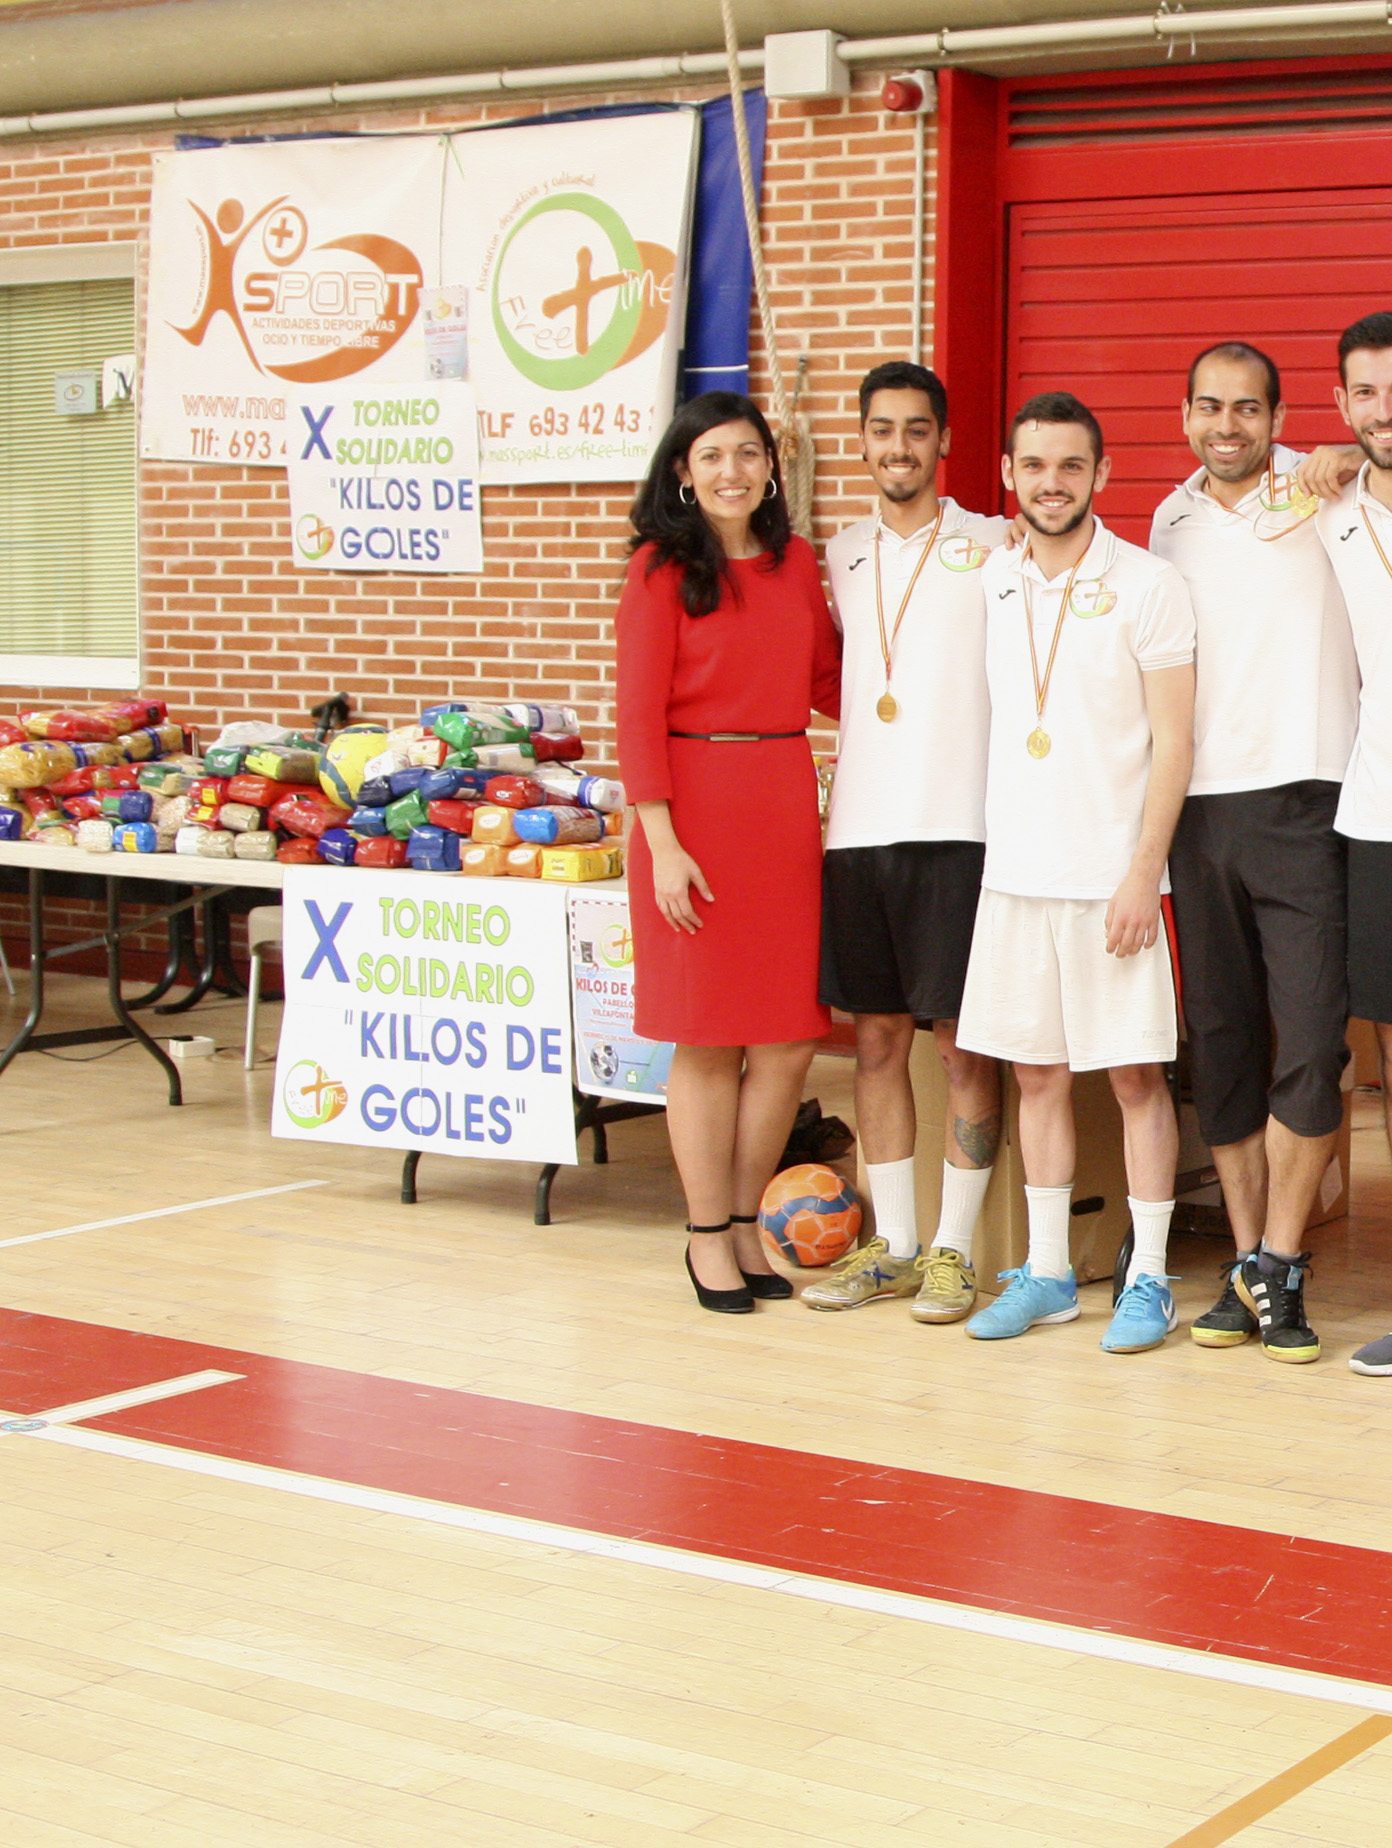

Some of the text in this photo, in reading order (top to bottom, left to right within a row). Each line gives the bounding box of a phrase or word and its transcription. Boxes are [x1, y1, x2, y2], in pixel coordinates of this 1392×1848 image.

[243, 271, 420, 316] SPORT
[251, 317, 396, 333] ACTIVIDADES DEPORTIVAS
[262, 333, 288, 346] OCIO
[289, 333, 298, 346] Y
[300, 333, 342, 347] TIEMPO
[352, 398, 440, 427] TORNEO
[528, 406, 570, 437] 693
[577, 402, 605, 436] 42
[613, 403, 641, 433] 43
[190, 428, 220, 458] Tlf:
[228, 430, 271, 460] 693
[299, 405, 335, 461] X
[335, 436, 454, 466] SOLIDARIO
[329, 477, 474, 512] "KILOS DE
[340, 526, 450, 562] GOLES"
[378, 896, 511, 947] TORNEO
[300, 899, 354, 984] X
[355, 952, 535, 1007] SOLIDARIO
[576, 977, 608, 994] KILOS
[611, 981, 628, 996] DE
[344, 1009, 563, 1075] "KILOS DE
[360, 1083, 527, 1145] GOLES"
